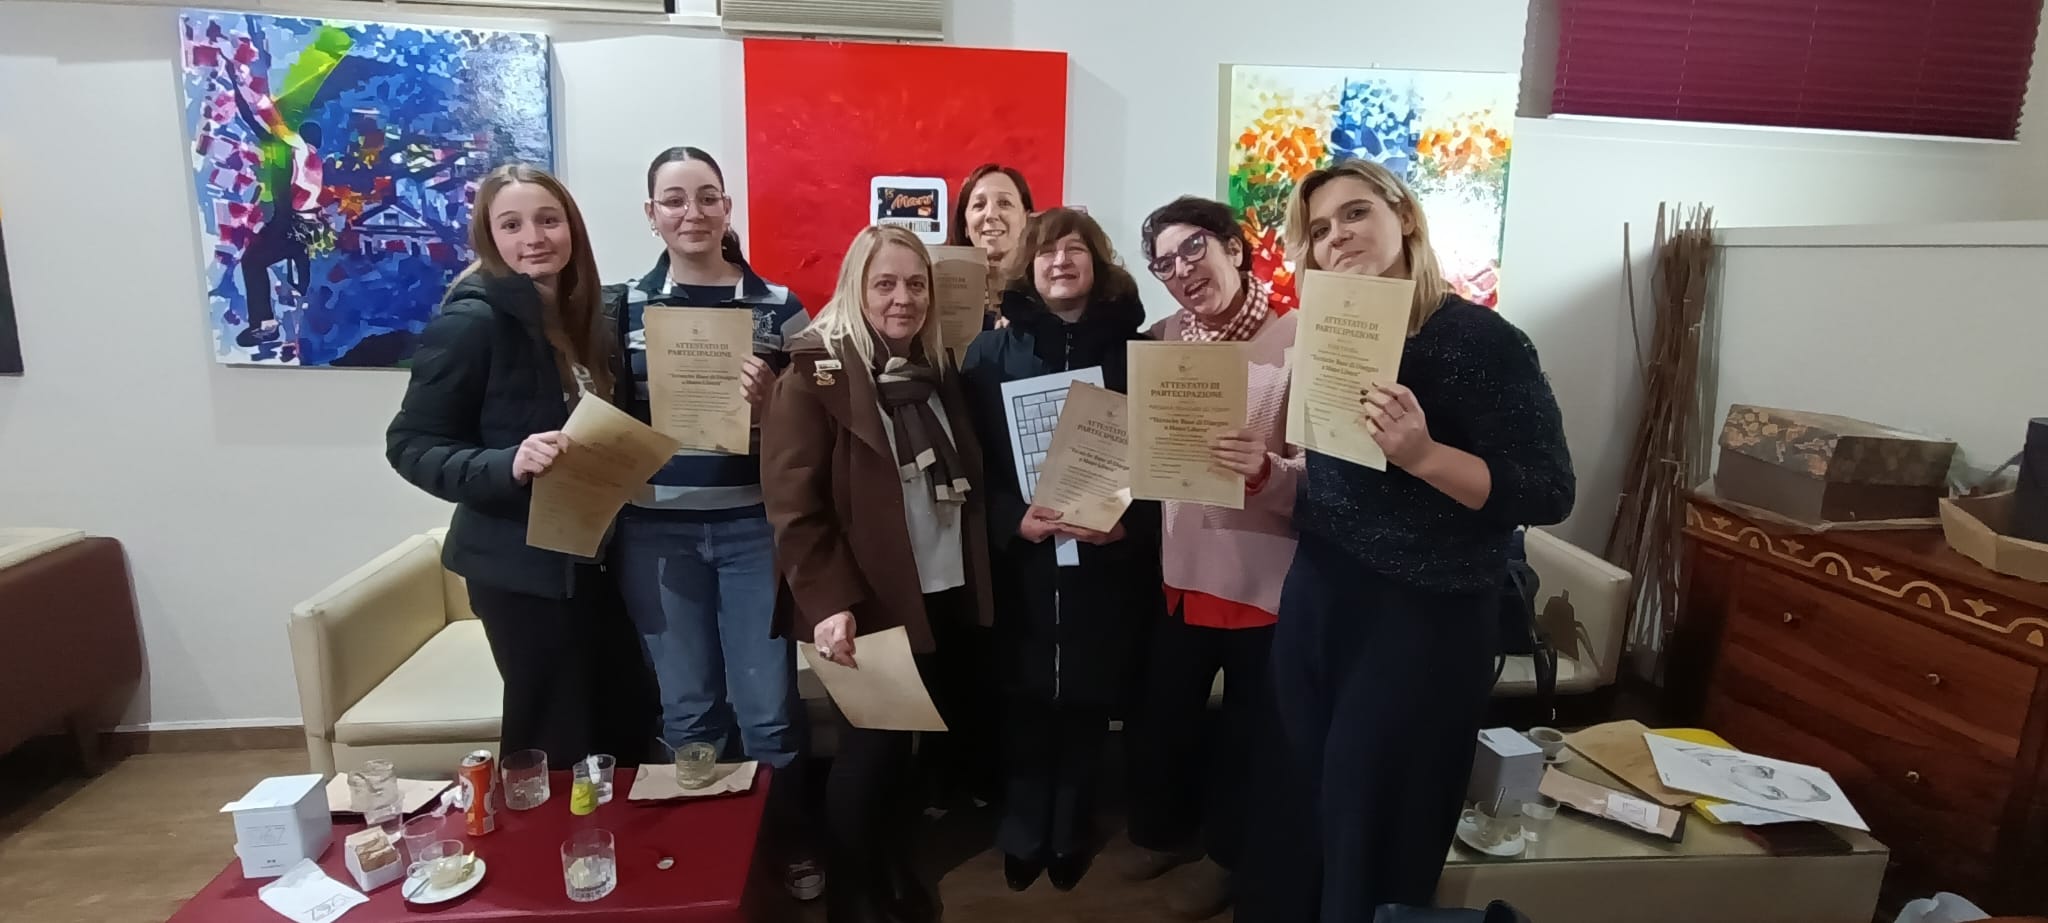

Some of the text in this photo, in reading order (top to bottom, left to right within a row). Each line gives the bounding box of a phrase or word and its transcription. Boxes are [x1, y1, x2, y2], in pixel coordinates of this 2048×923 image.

[1324, 316, 1379, 331] ATTESTATO DI
[1315, 323, 1380, 341] PARTECIPAZIONE
[675, 342, 719, 350] ATTESTATO
[667, 349, 732, 358] PARTECIPAZIONE
[1160, 381, 1220, 390] ATTESTATO DI
[1150, 389, 1224, 399] PARTECIPAZIONE
[1088, 420, 1127, 437] ATTESTATO
